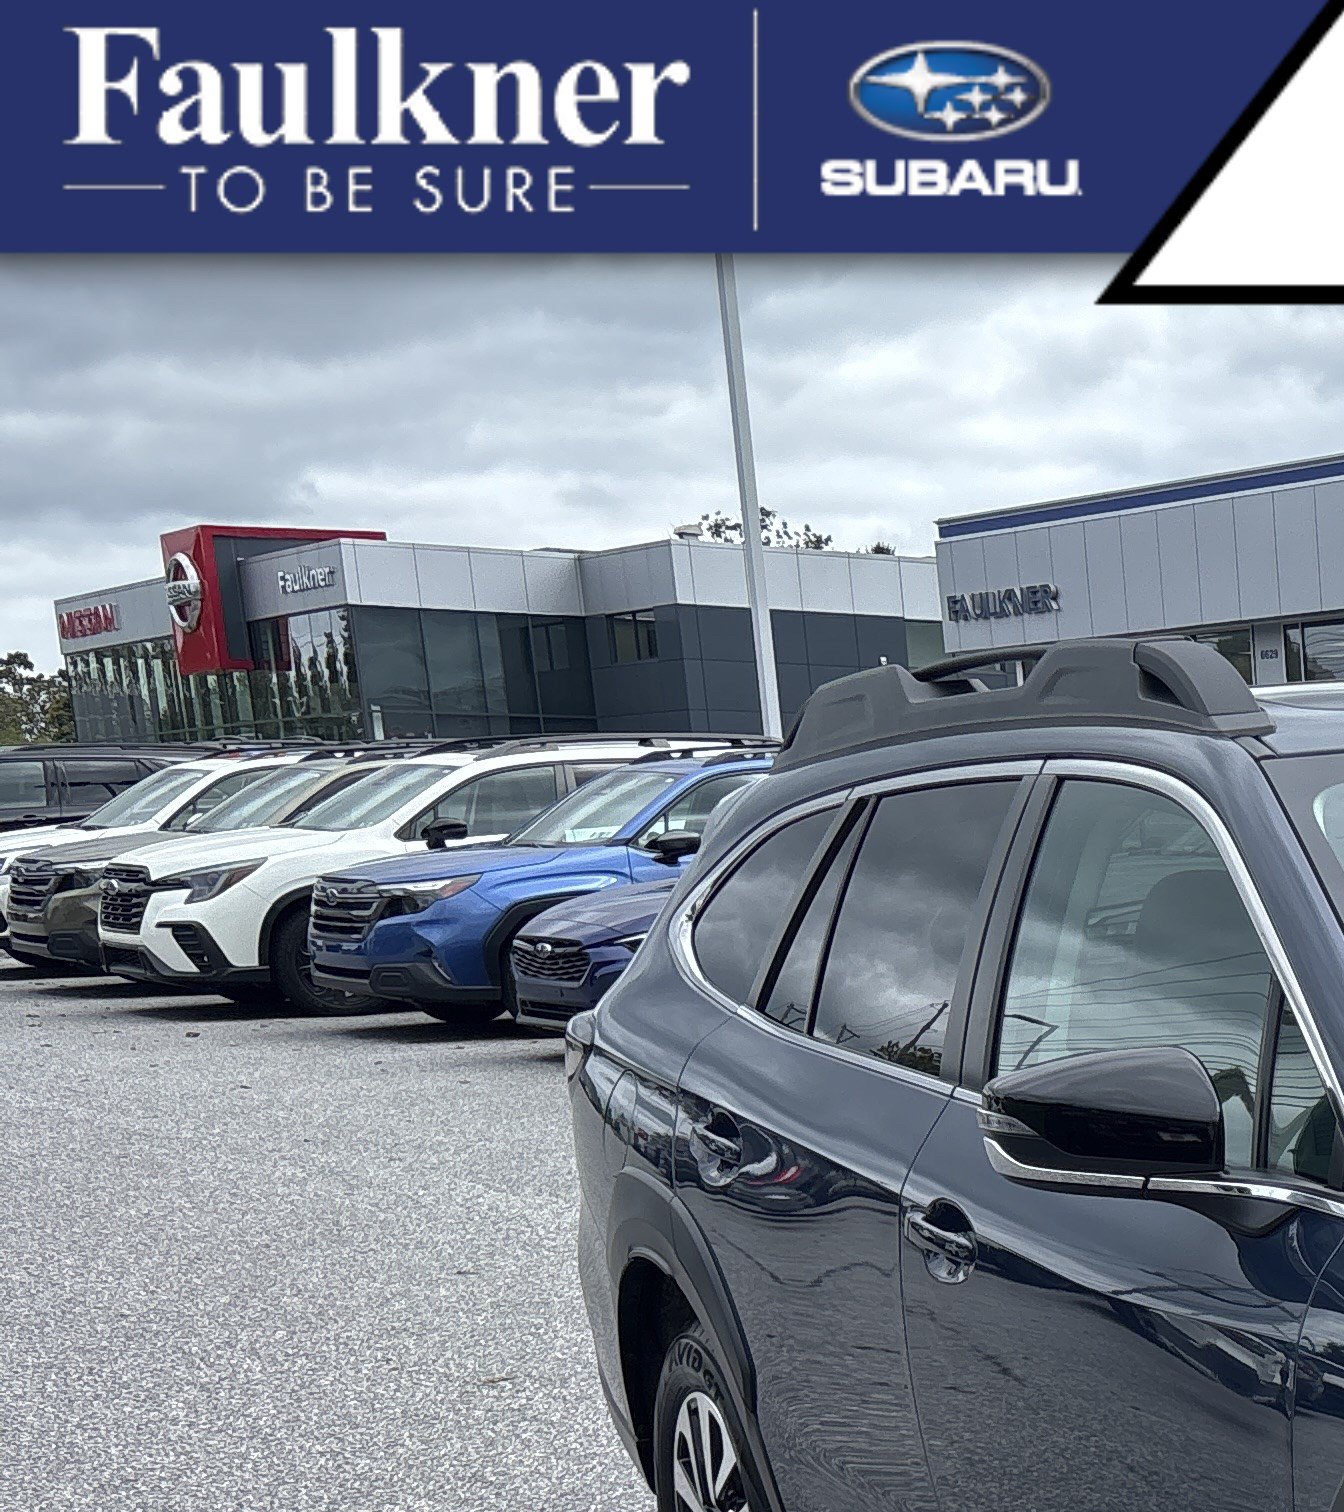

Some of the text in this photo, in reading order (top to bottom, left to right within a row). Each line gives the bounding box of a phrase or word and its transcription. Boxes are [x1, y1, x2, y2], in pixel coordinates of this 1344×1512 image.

[277, 565, 334, 594] Faulkner
[946, 583, 1060, 621] FAULKNER
[58, 604, 119, 639] NISSAN
